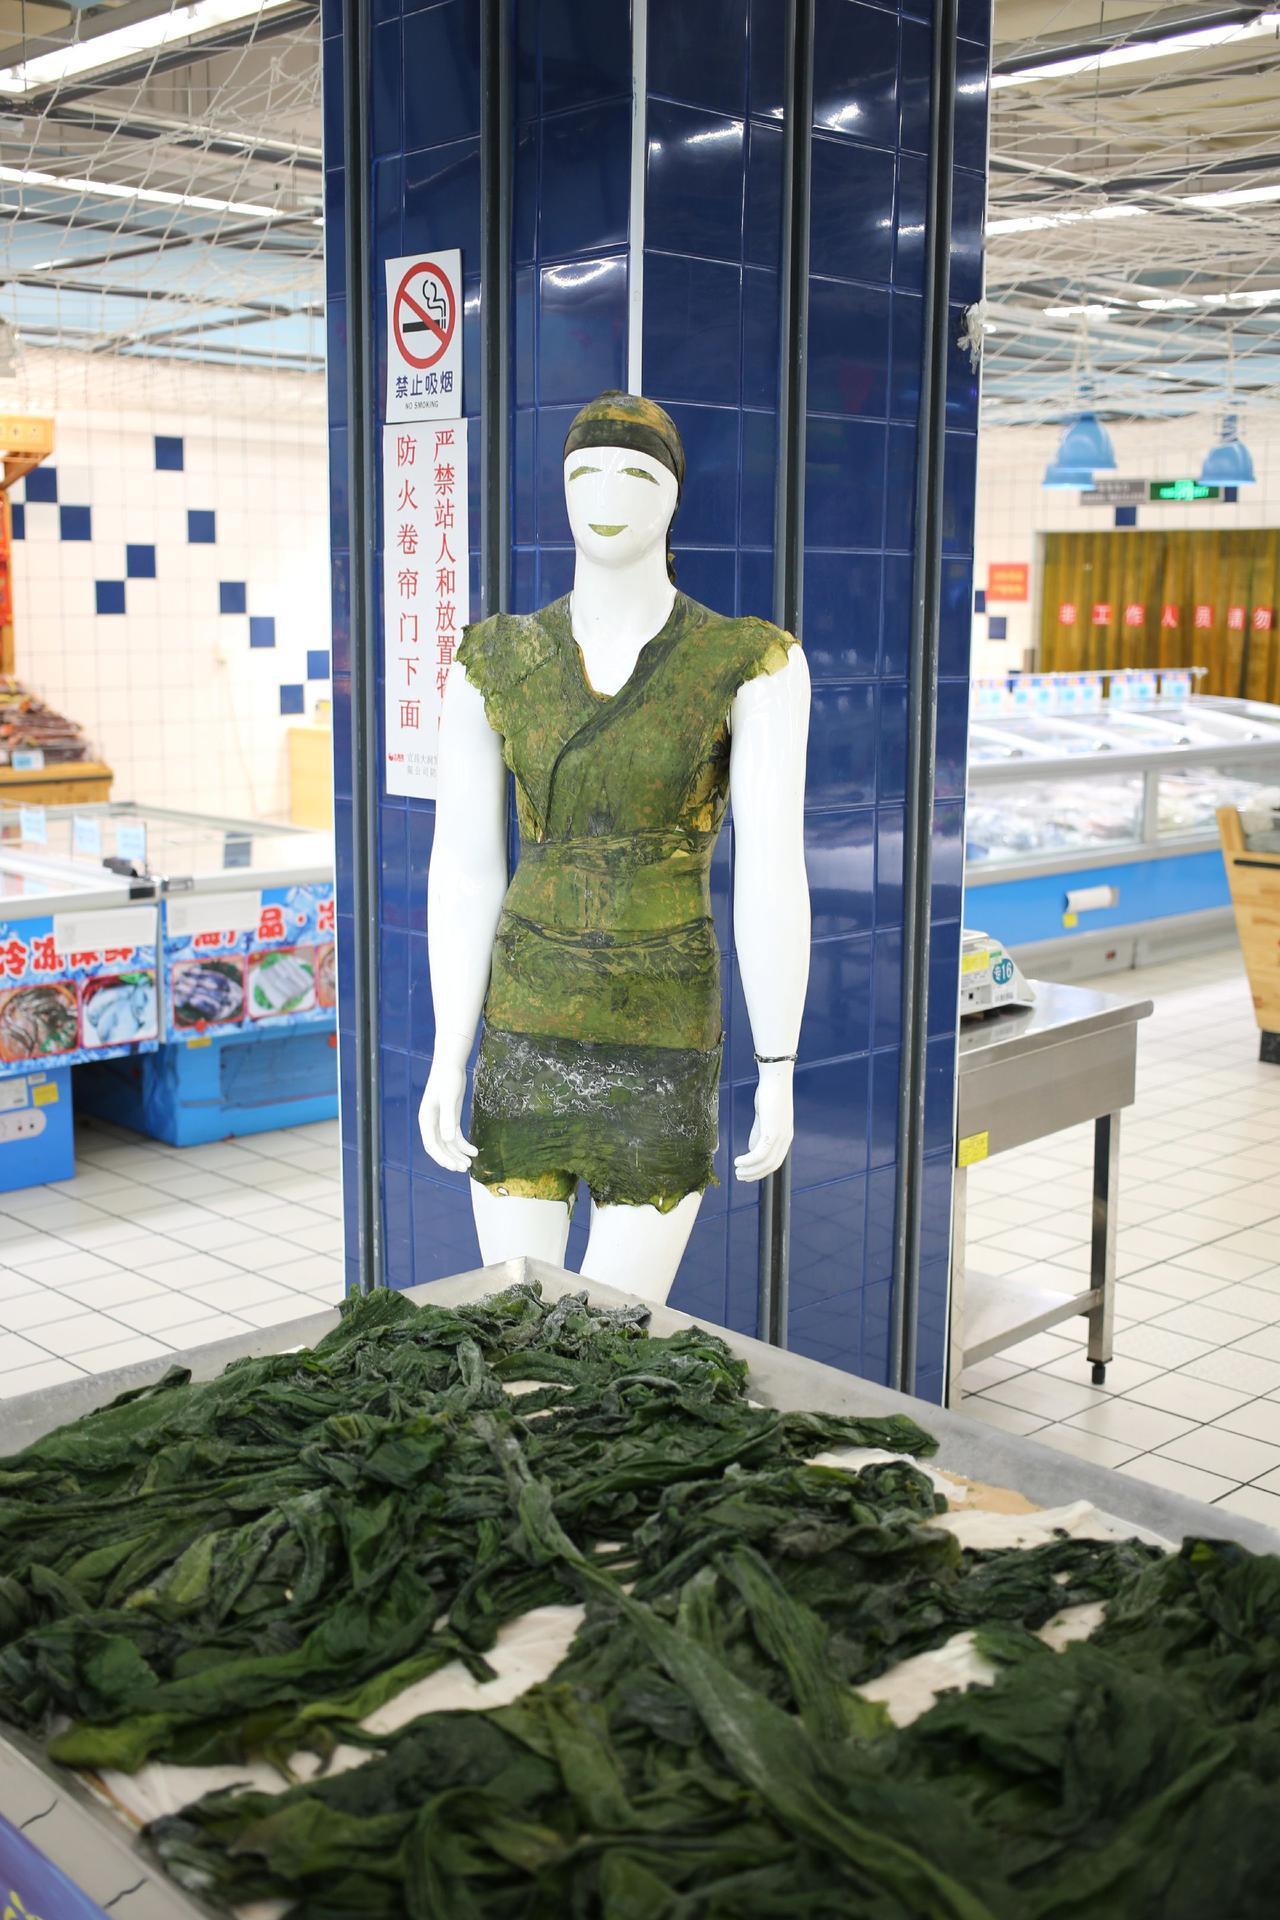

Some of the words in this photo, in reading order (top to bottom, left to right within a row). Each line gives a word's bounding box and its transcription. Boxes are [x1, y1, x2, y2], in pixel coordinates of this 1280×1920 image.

[395, 370, 453, 398] 禁止吸烟
[405, 402, 413, 410] NO
[414, 400, 439, 410] SMOKING
[396, 434, 420, 729] 防火卷帘门下面
